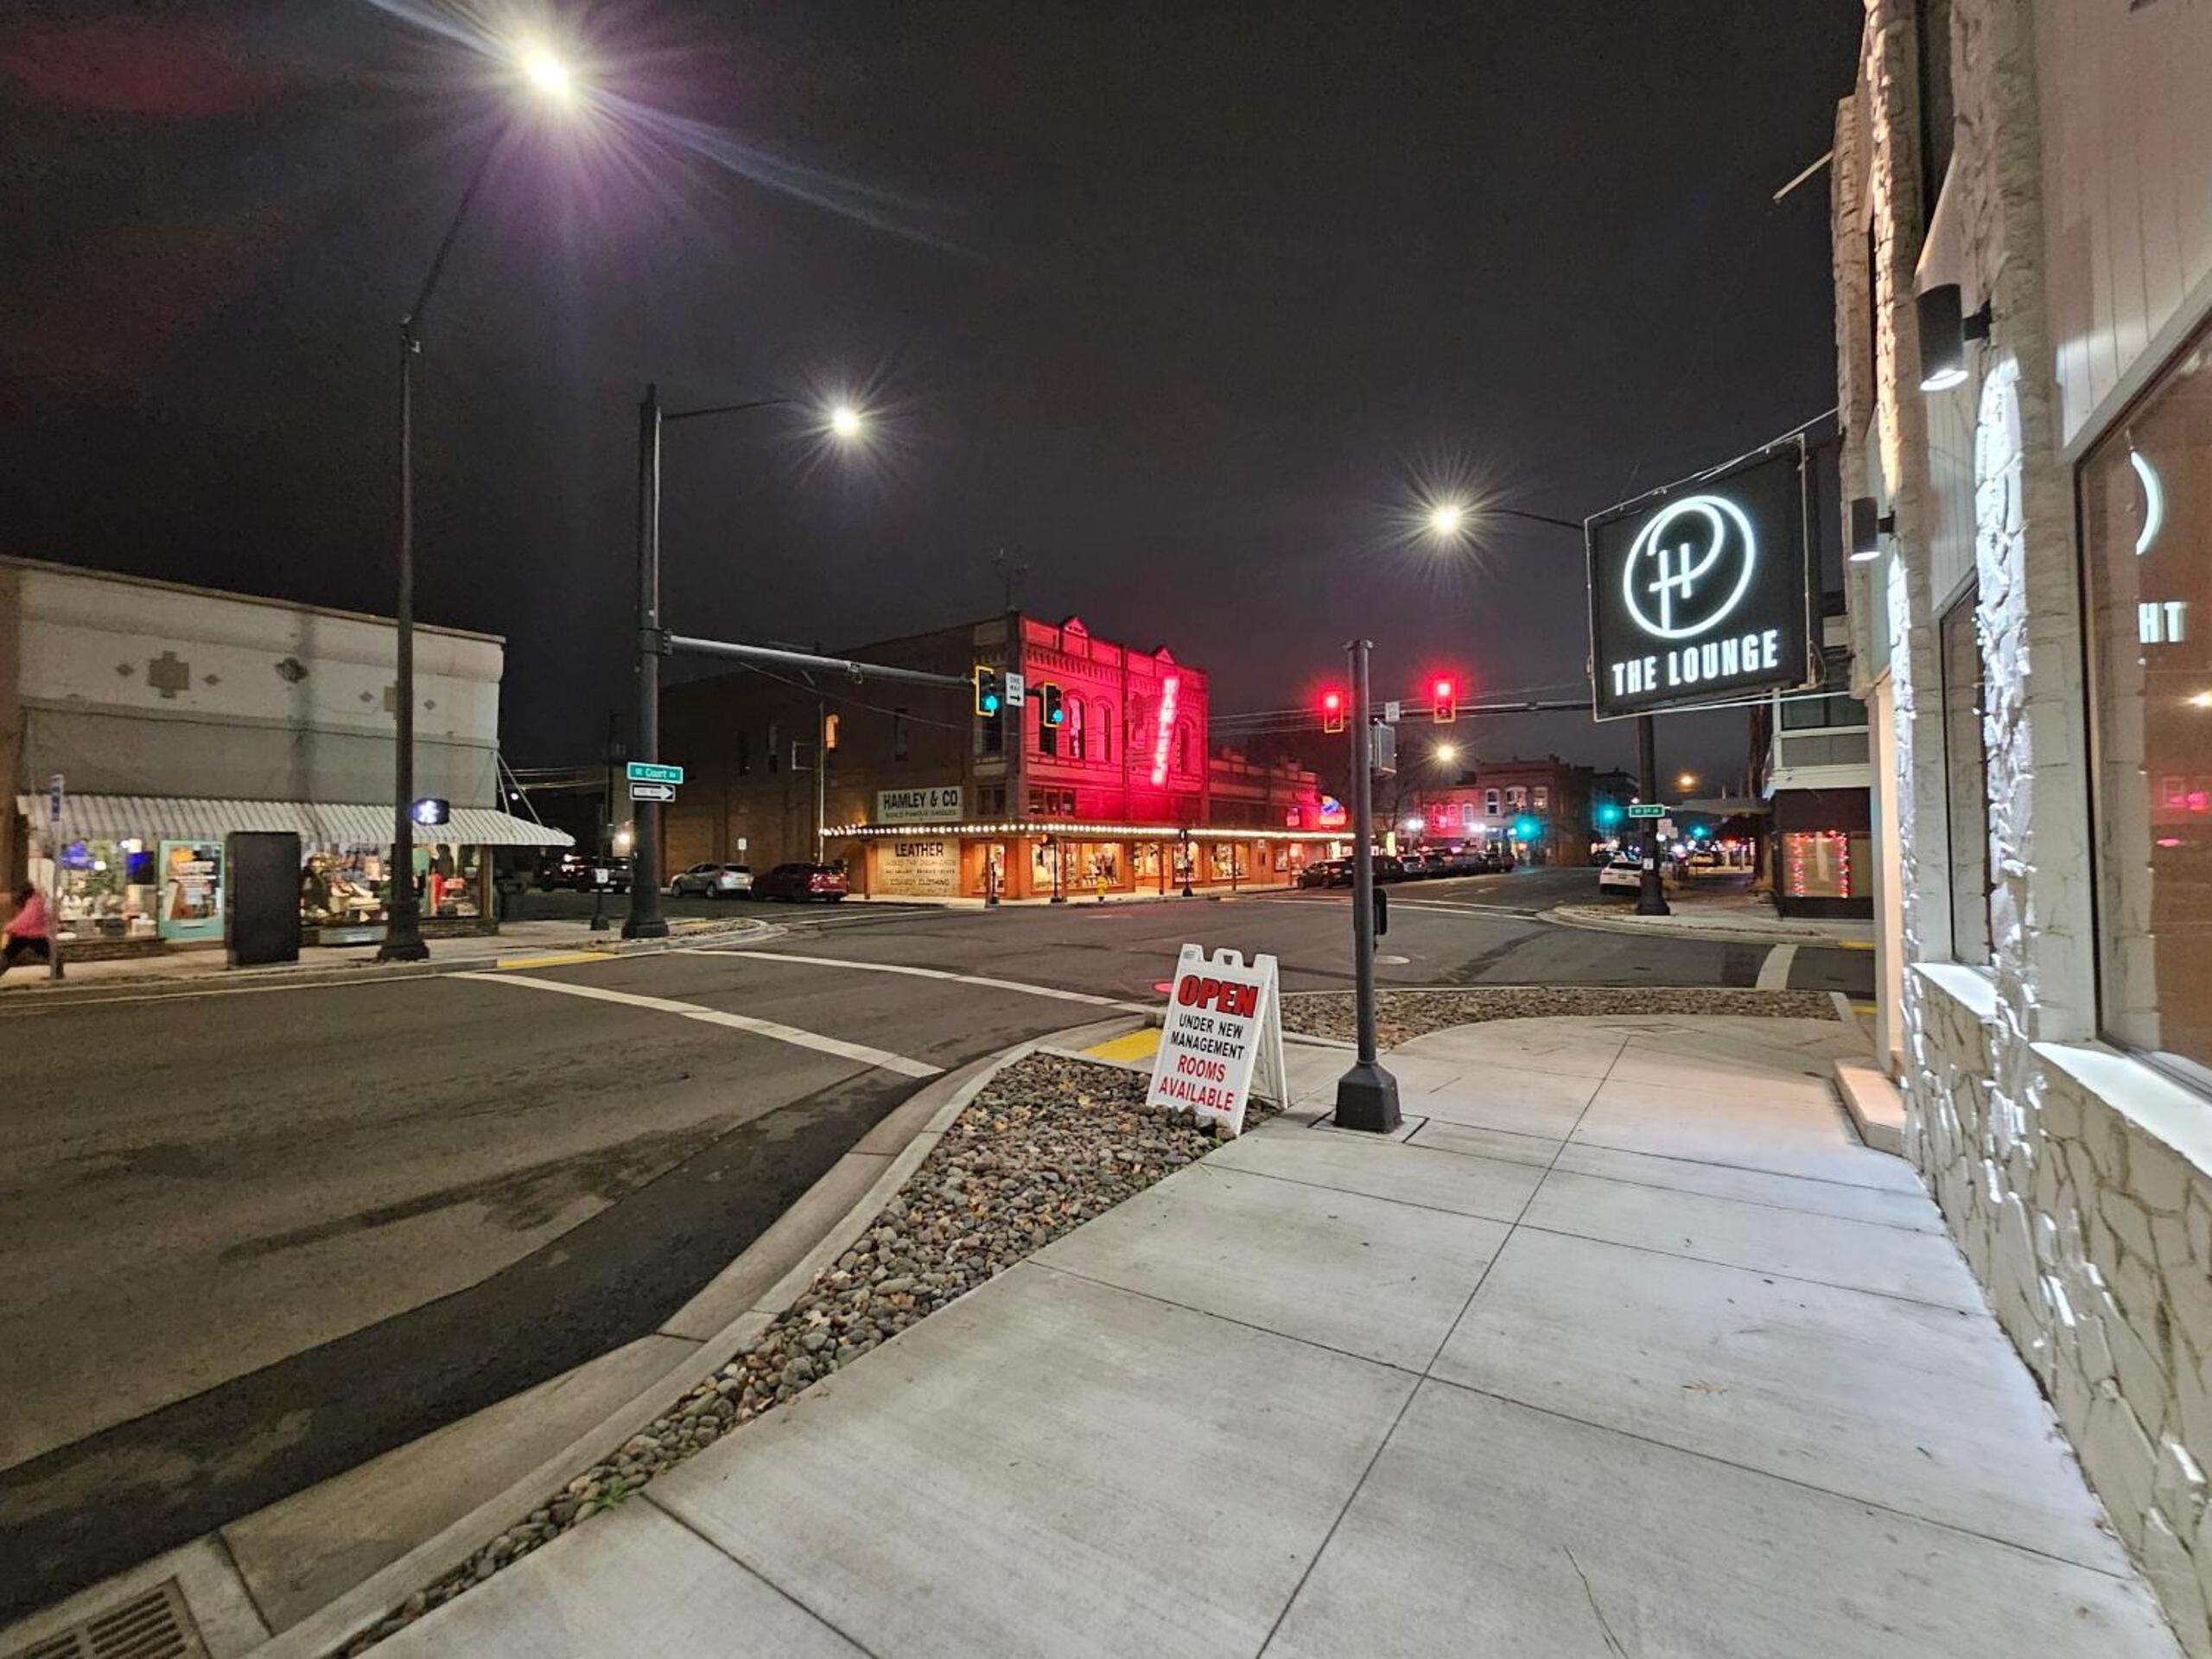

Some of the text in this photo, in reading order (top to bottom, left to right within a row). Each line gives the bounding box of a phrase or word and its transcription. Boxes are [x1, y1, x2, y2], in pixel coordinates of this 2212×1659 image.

[1612, 629, 1778, 696] THE LOUNGE
[645, 767, 667, 779] Court
[884, 790, 957, 810] HAMLEY & CO
[894, 842, 944, 857] LEATHER
[1178, 974, 1258, 1018] OPEN
[1179, 1014, 1243, 1039] UNDER NEW
[1171, 1031, 1244, 1059] MANAGEMENT
[1178, 1054, 1225, 1082] ROOMS
[1159, 1077, 1234, 1111] AVAILABLE
